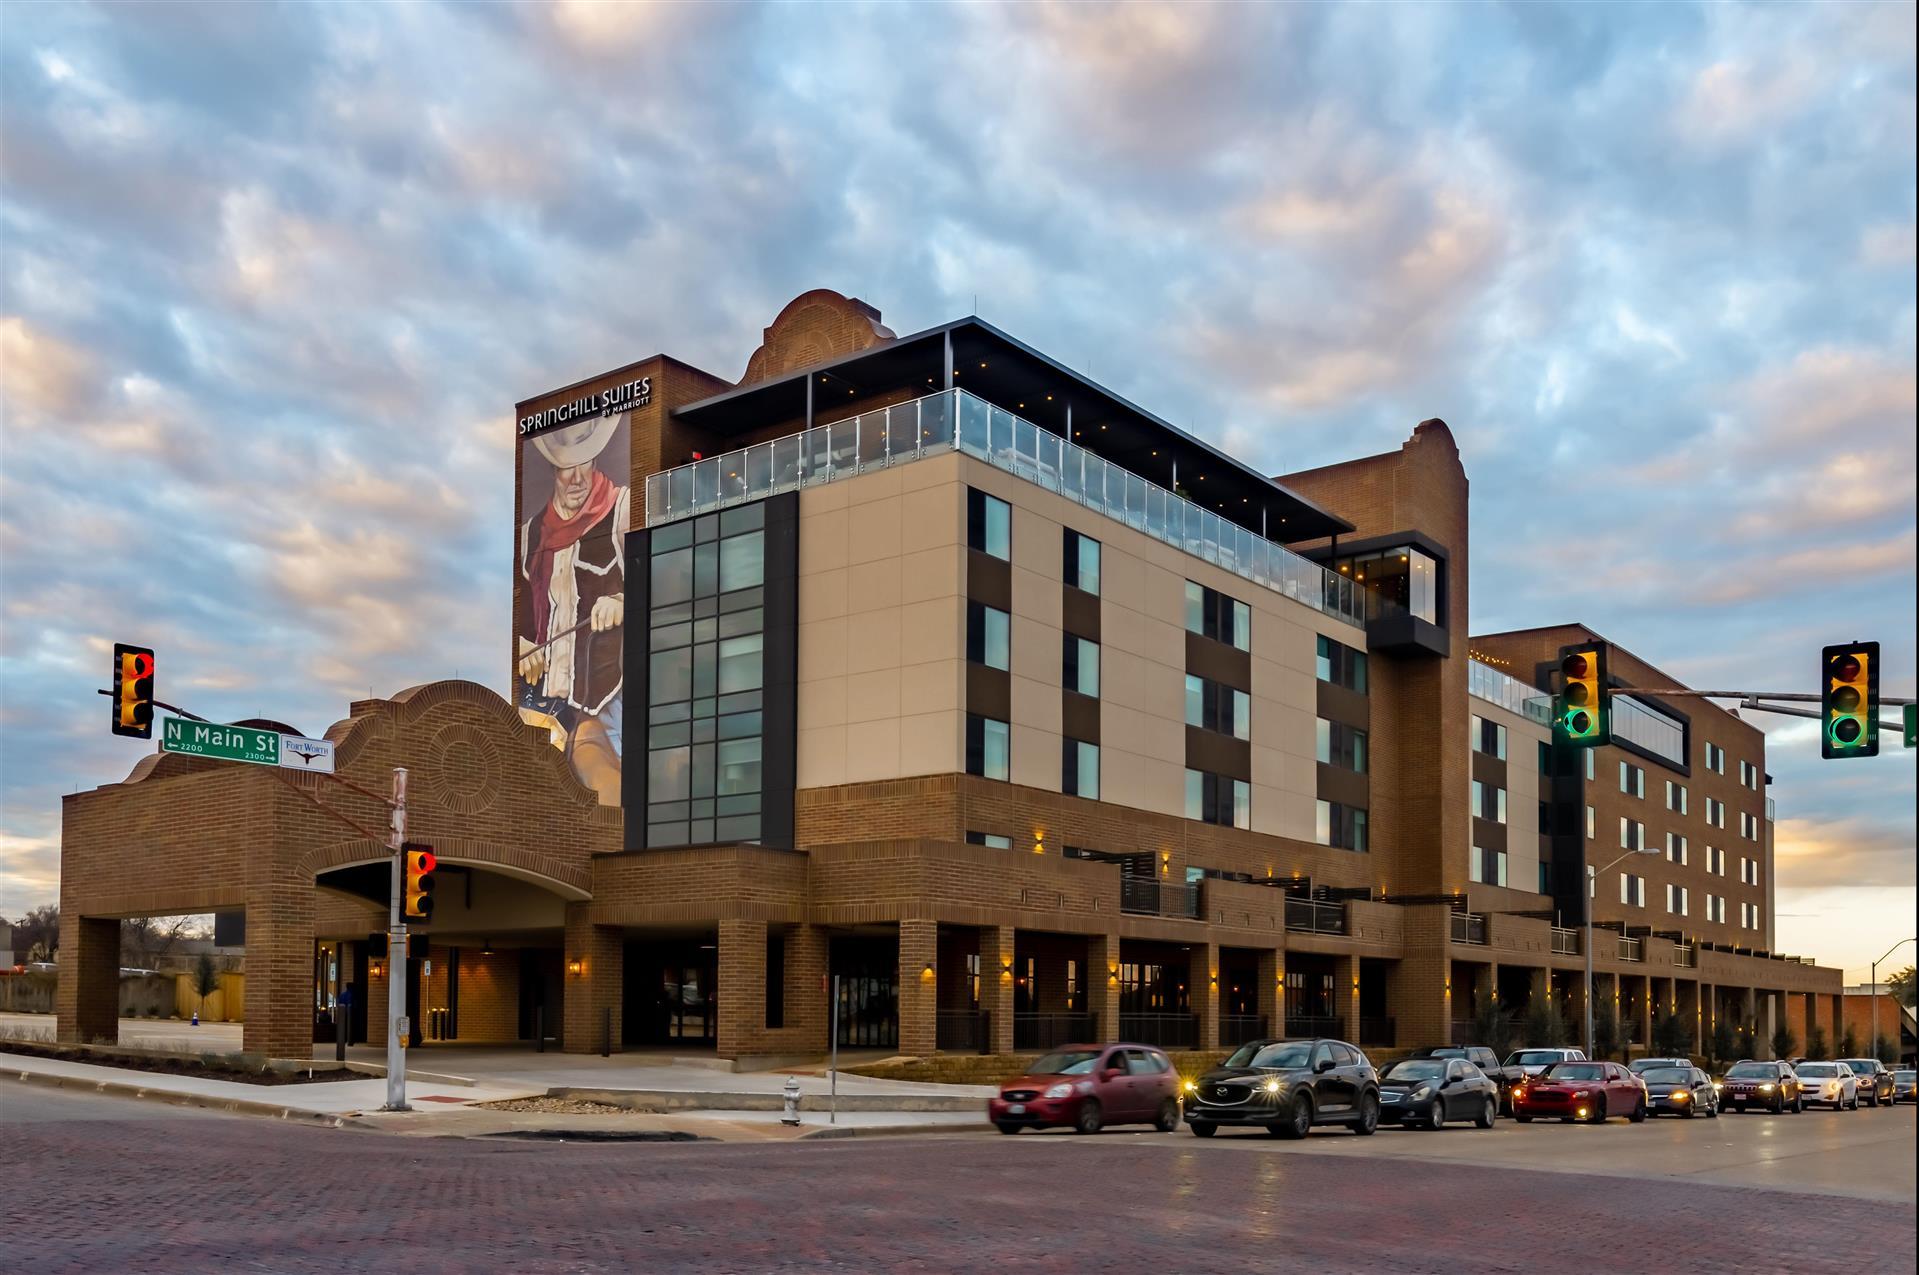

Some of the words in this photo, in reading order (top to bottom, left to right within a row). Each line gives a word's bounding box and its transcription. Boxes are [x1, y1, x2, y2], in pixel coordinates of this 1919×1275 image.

[520, 395, 598, 434] SPRINGHILL
[602, 377, 650, 408] SUITES
[602, 409, 611, 417] BY
[613, 396, 650, 414] MARRIOTT
[167, 722, 181, 740] N
[195, 726, 244, 748] Main
[256, 735, 275, 753] St
[181, 743, 203, 752] 2200
[245, 752, 265, 761] 2300
[286, 740, 303, 751] FORT
[304, 742, 328, 755] WORTH
